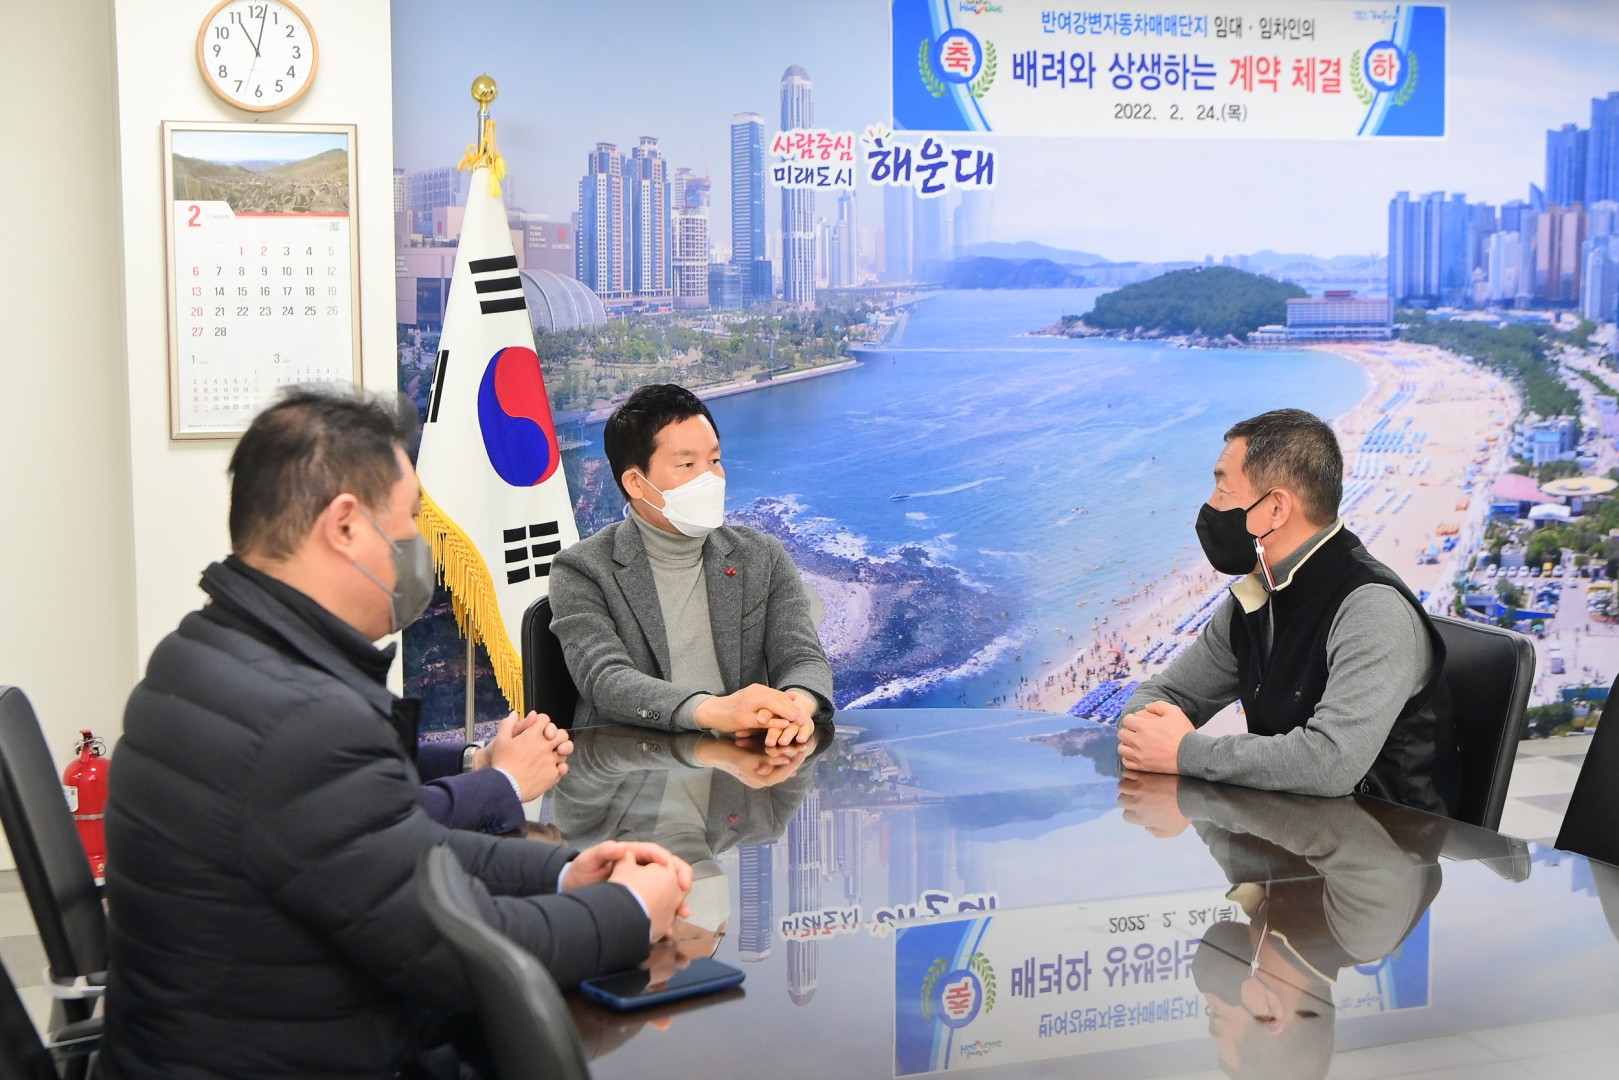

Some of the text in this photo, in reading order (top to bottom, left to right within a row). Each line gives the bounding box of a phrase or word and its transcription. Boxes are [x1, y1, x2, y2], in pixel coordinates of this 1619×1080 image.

[229, 12, 241, 24] 11
[248, 5, 264, 18] 12
[273, 12, 278, 24] 1
[286, 25, 295, 38] 2
[1041, 10, 1208, 38] 반여강변자동차매매단지
[1214, 15, 1242, 38] 임대
[1259, 17, 1315, 40] 임차인의
[215, 26, 230, 40] 10
[212, 44, 222, 58] 9
[292, 46, 302, 60] 3
[944, 42, 971, 72] 축
[218, 65, 228, 78] 8
[286, 66, 296, 78] 4
[1012, 50, 1342, 94] 배려와 상생하는 계약 체결
[1373, 53, 1395, 81] 하
[234, 80, 243, 93] 7
[254, 84, 264, 98] 6
[275, 80, 284, 93] 5
[1114, 103, 1248, 122] 2022. 2. 24.(목)
[773, 133, 853, 161] 사람중심
[867, 137, 994, 194] 해운대
[773, 164, 852, 186] 미래도시
[188, 204, 202, 228] 2
[239, 246, 244, 256] 1
[260, 246, 268, 256] 2
[283, 246, 290, 256] 3
[306, 246, 312, 256] 4
[192, 267, 199, 277] 6
[216, 267, 222, 277] 7
[238, 267, 245, 277] 8
[261, 266, 268, 276] 9
[282, 266, 292, 276] 10
[306, 266, 313, 276] 11
[192, 287, 202, 297] 13
[214, 287, 225, 297] 14
[238, 287, 248, 296] 15
[260, 287, 270, 296] 16
[284, 287, 292, 296] 17
[305, 286, 315, 296] 18
[190, 308, 204, 317] 20
[215, 307, 225, 317] 21
[236, 307, 249, 317] 22
[260, 307, 272, 316] 23
[282, 307, 294, 316] 24
[304, 307, 316, 316] 25
[192, 328, 227, 337] 27 28
[274, 354, 280, 364] 3
